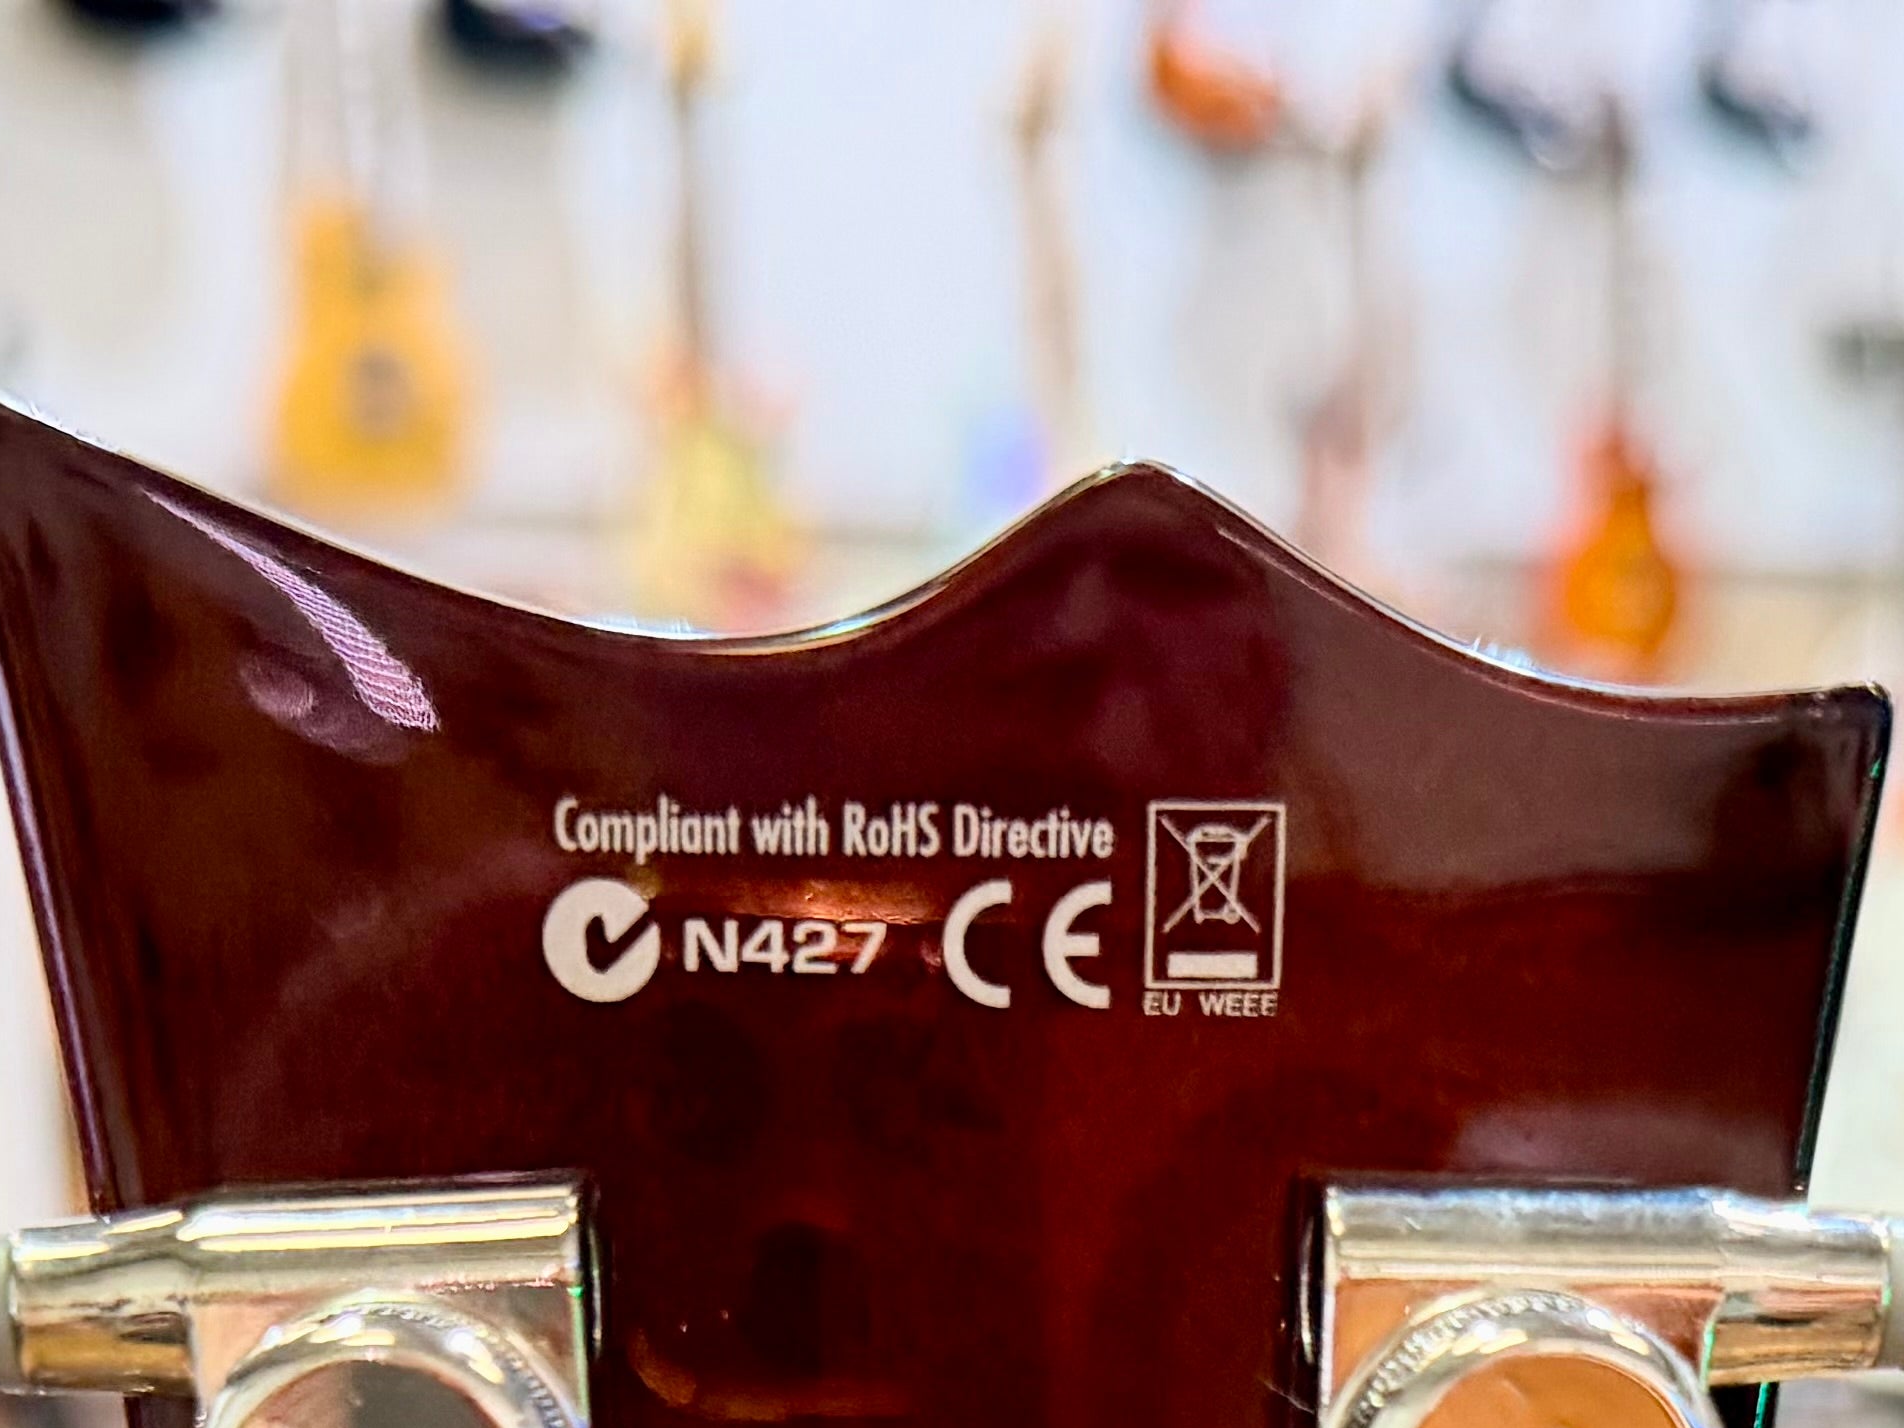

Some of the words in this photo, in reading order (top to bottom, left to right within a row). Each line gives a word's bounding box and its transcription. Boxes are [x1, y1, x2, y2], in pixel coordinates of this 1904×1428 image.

[554, 794, 741, 865] Compliant
[752, 795, 829, 857] with
[842, 800, 940, 858] RoHS
[953, 803, 1115, 859] Directive
[682, 917, 888, 975] N427
[942, 878, 1113, 1009] CE
[1143, 991, 1182, 1017] EU
